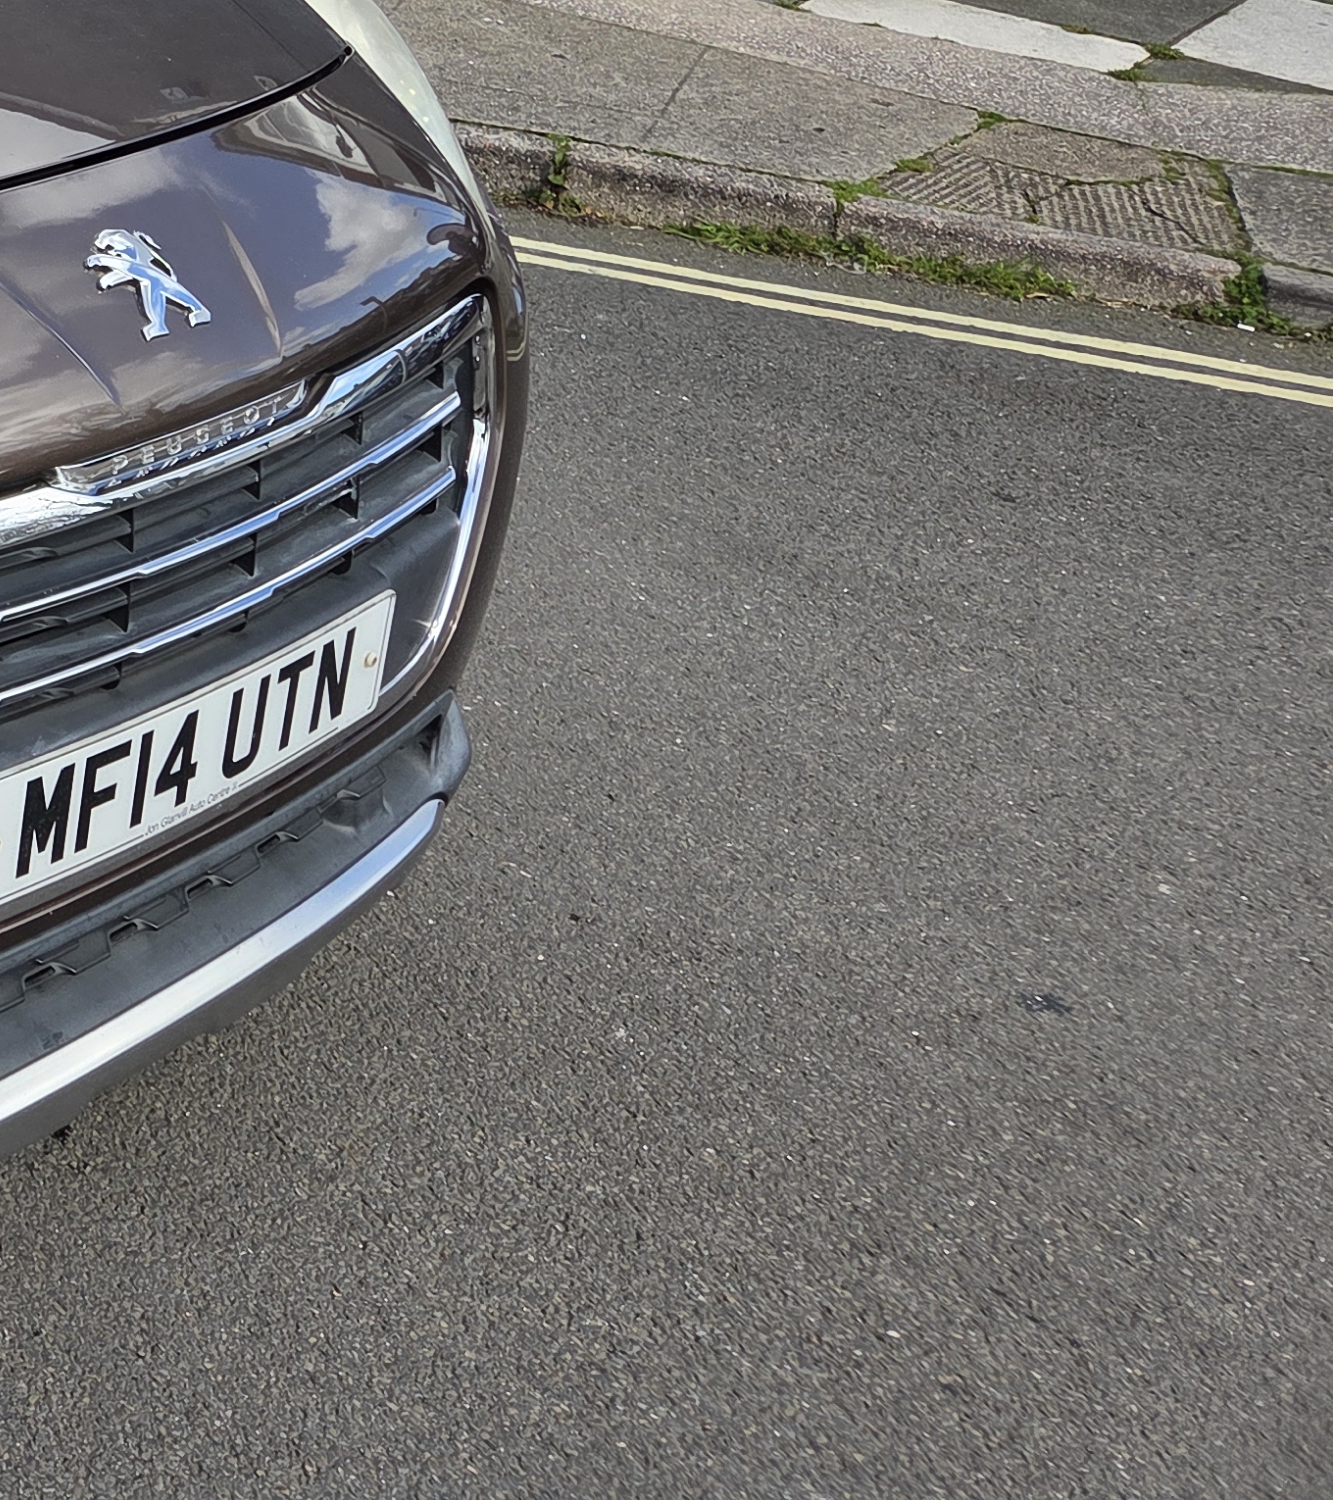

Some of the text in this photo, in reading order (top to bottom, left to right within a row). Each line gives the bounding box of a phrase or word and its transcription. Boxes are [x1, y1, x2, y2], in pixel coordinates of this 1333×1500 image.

[112, 395, 283, 475] PEUGEOT
[16, 626, 357, 879] MF14 UTN
